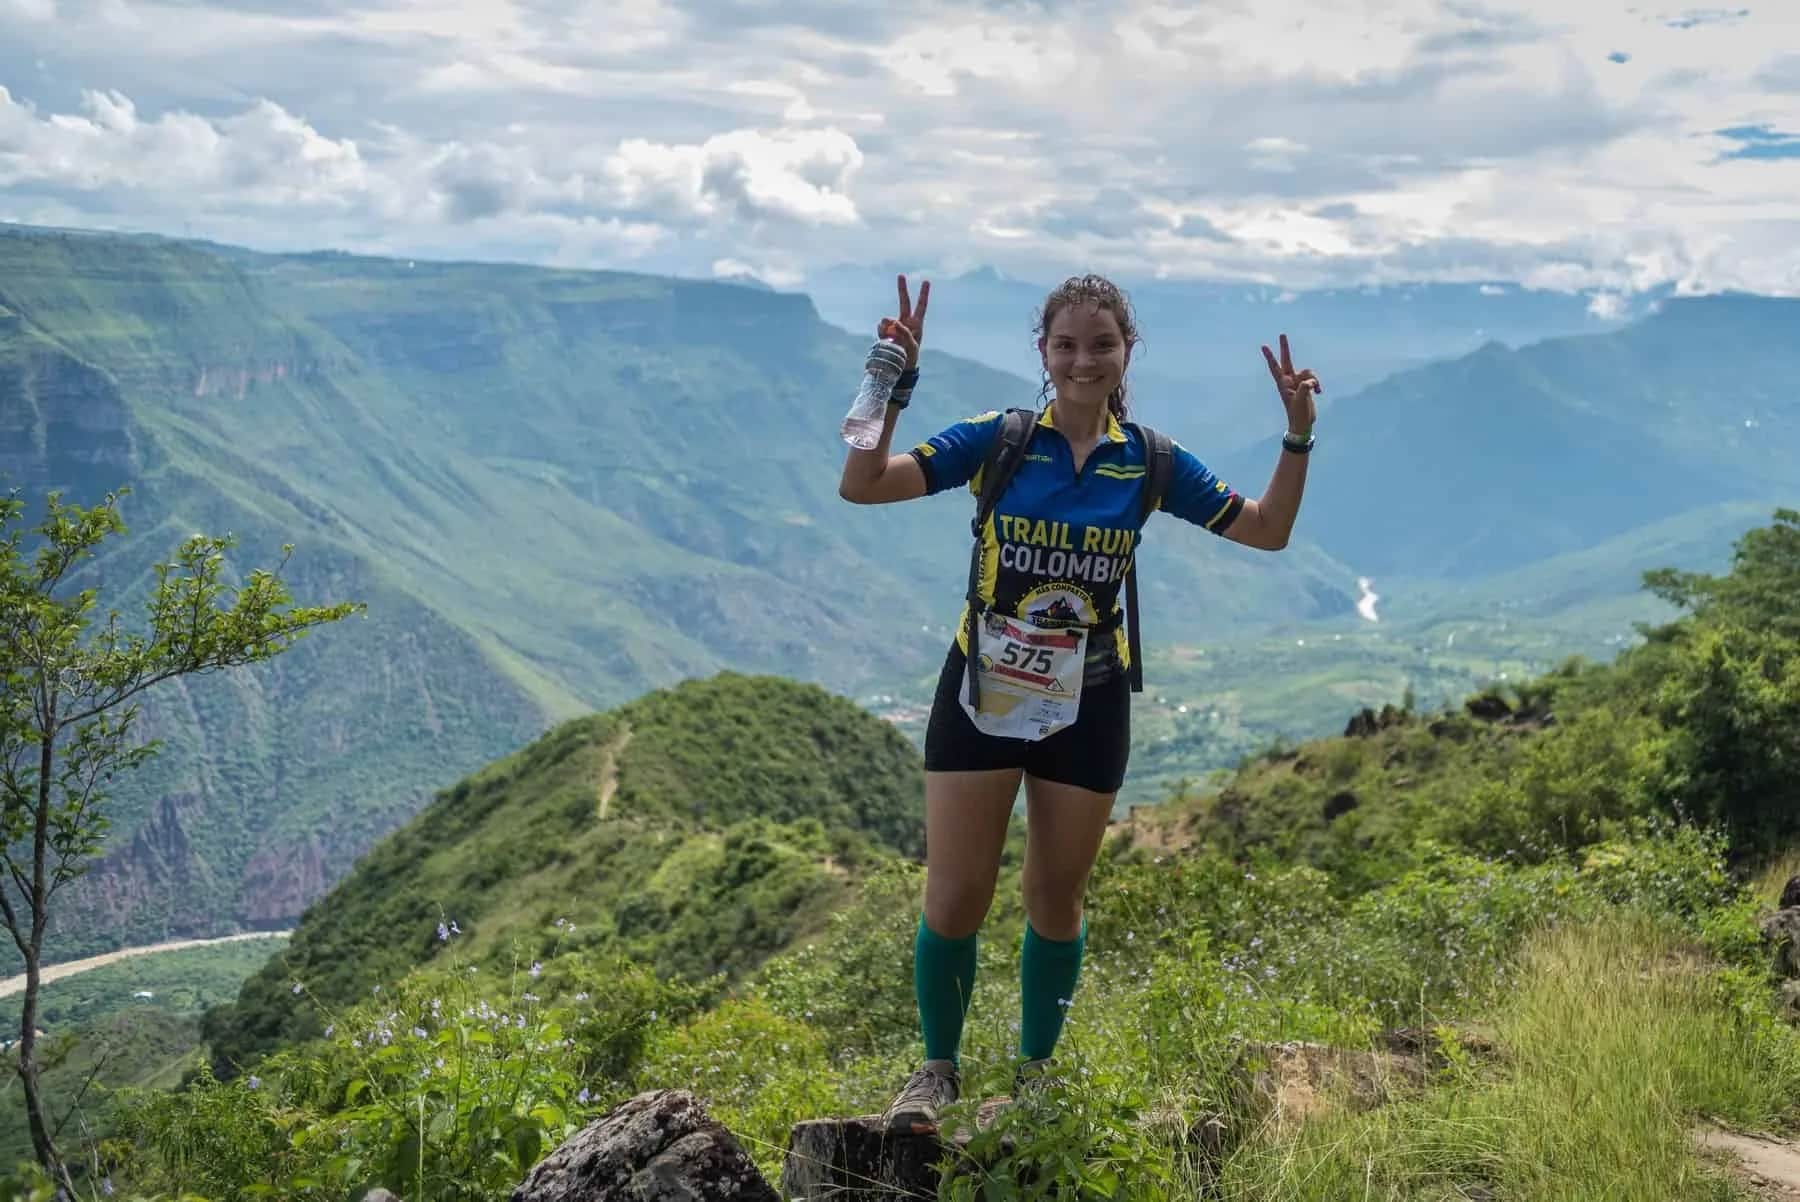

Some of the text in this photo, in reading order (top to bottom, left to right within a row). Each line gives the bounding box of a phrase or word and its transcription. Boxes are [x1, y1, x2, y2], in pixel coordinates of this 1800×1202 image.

[1000, 515, 1135, 555] TRAIL RUN
[1000, 642, 1054, 674] 575
